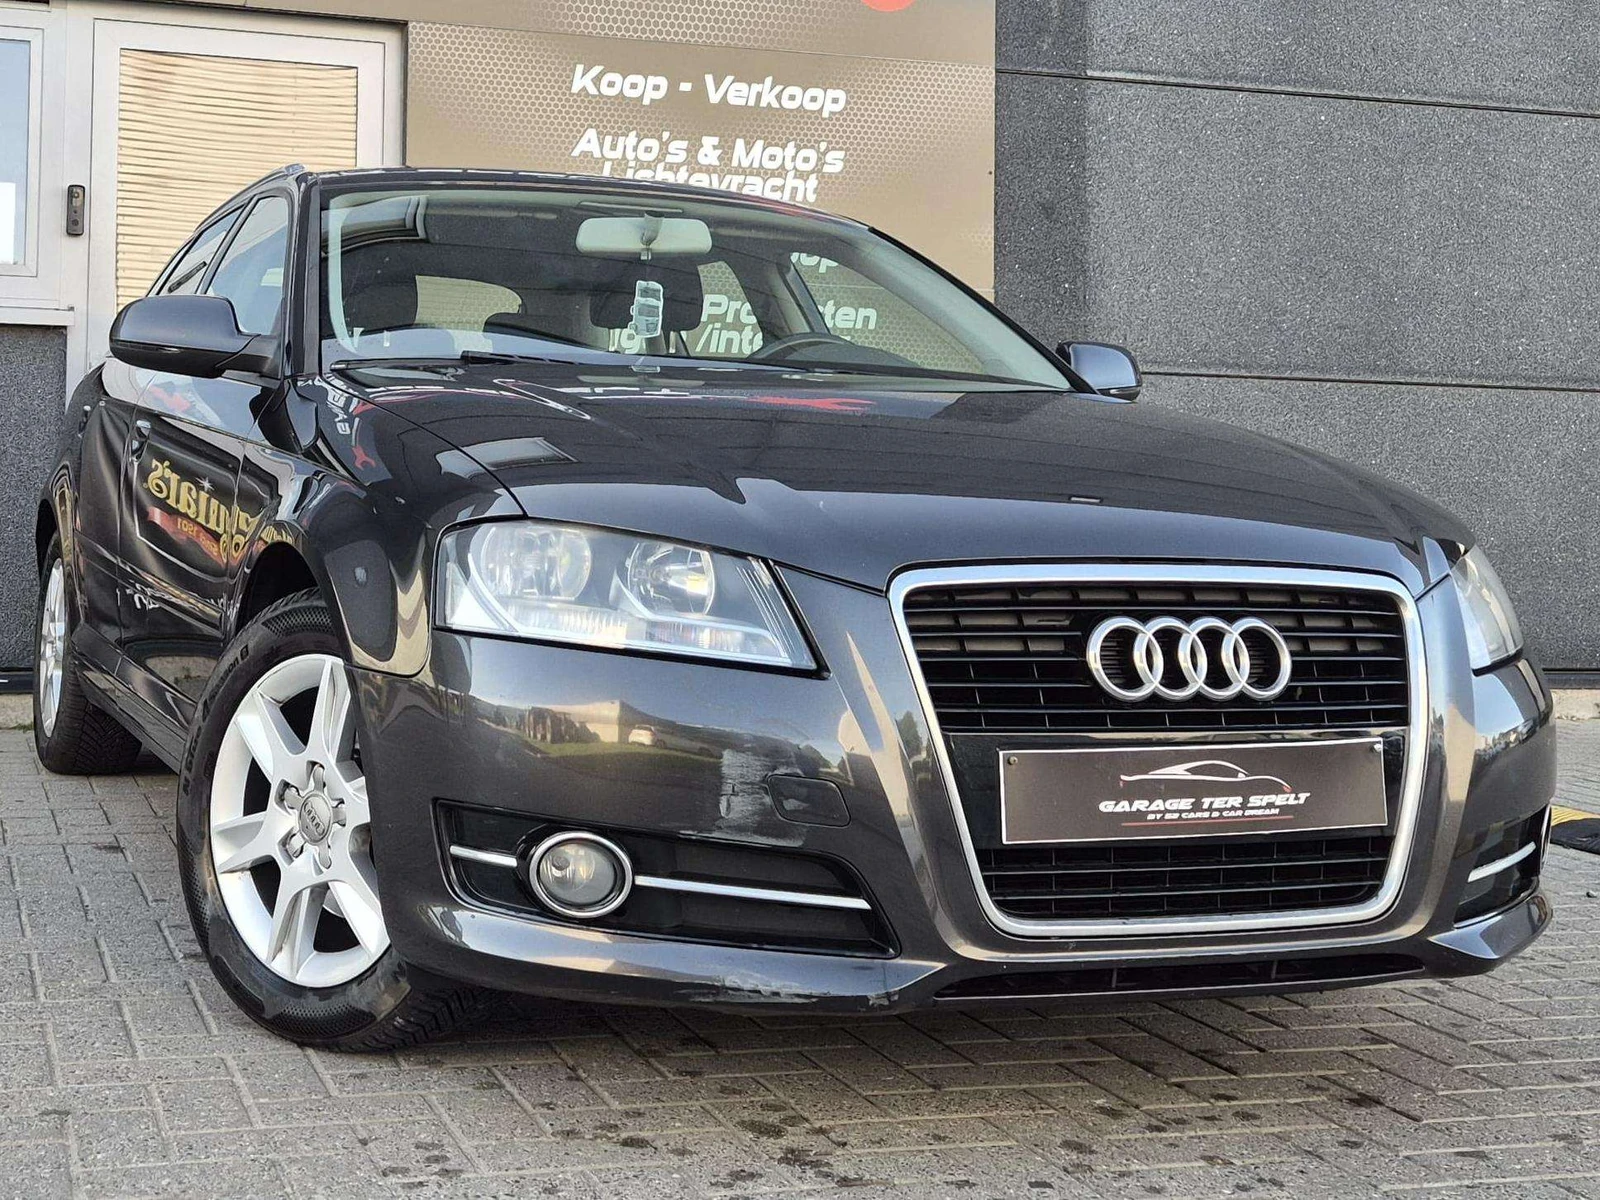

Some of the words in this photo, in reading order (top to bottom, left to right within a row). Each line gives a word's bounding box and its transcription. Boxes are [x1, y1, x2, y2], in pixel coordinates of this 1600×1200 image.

[571, 64, 668, 105] Koop
[704, 74, 847, 118] Verkoop
[571, 128, 688, 163] Auto's
[697, 136, 722, 166] &
[732, 138, 845, 173] Moto's
[1099, 798, 1195, 812] GARAGE
[1201, 797, 1242, 809] TER
[1247, 793, 1311, 806] SPELT
[1222, 809, 1244, 817] CAR
